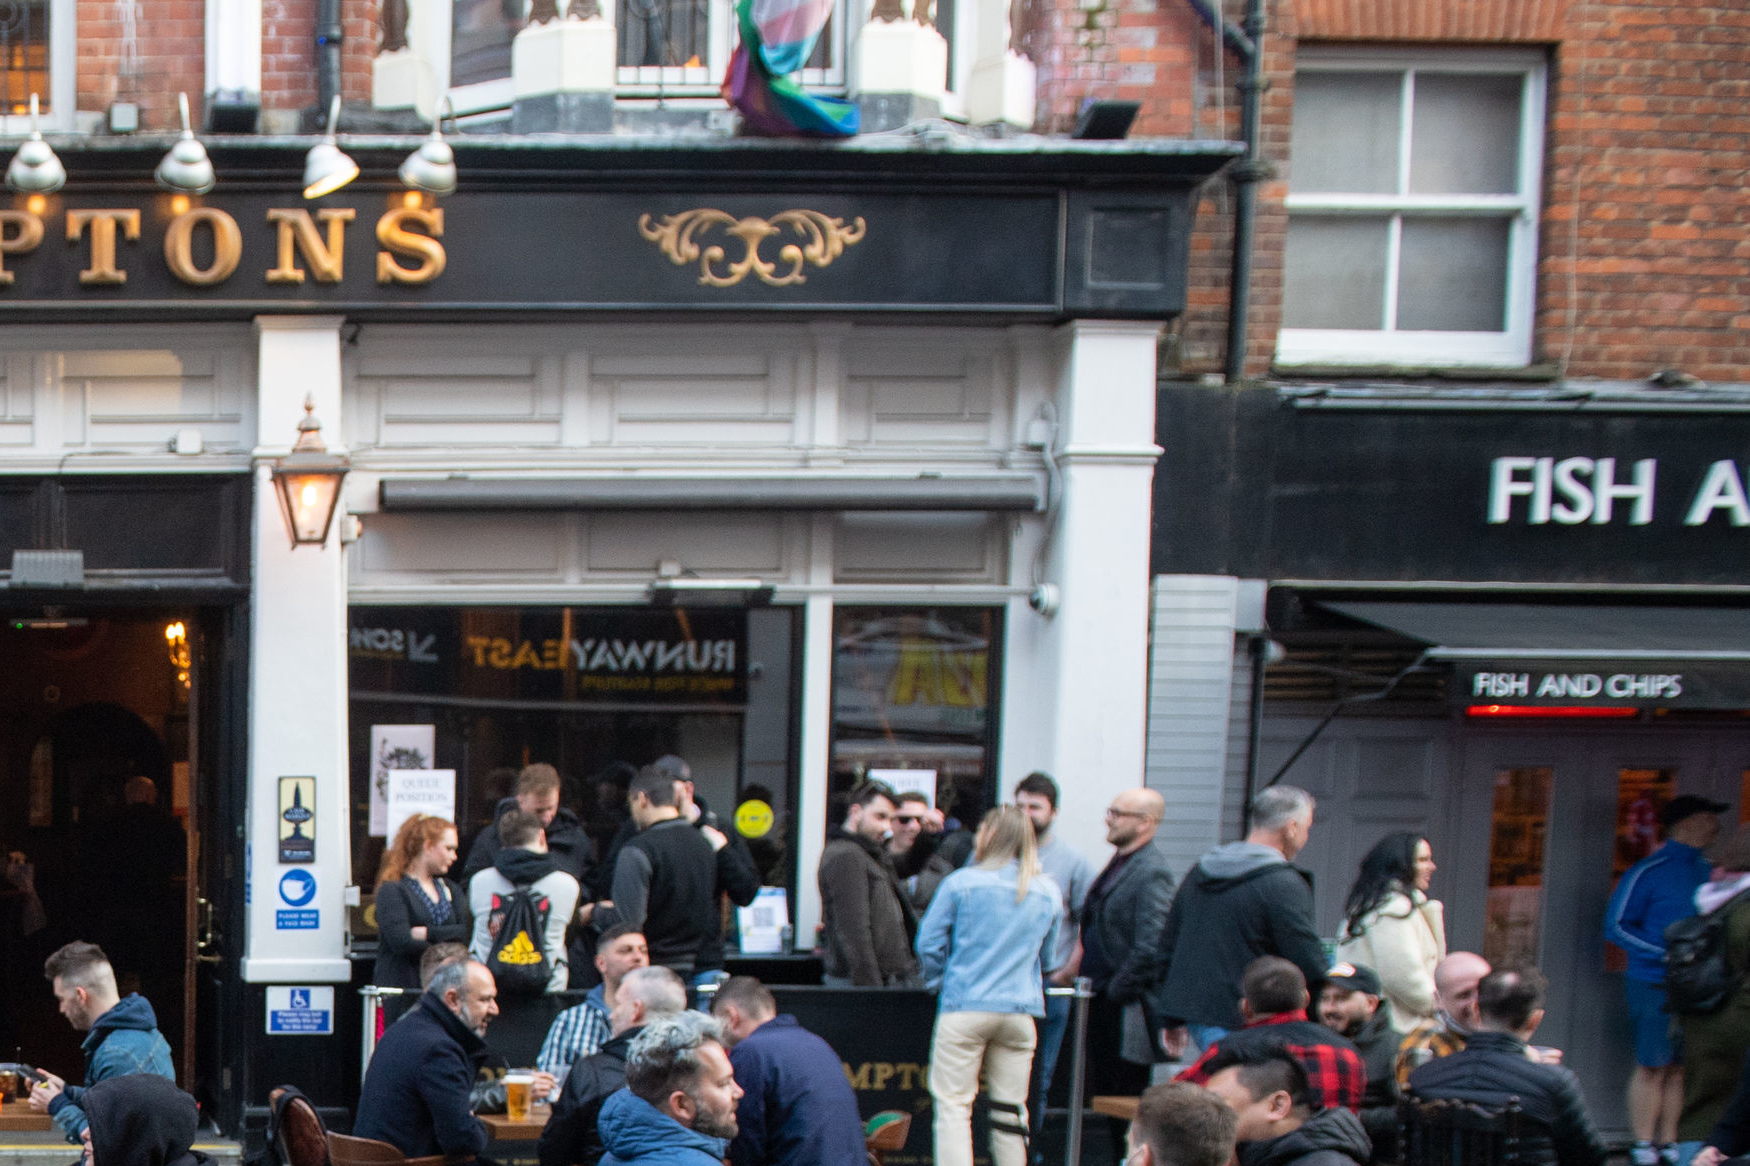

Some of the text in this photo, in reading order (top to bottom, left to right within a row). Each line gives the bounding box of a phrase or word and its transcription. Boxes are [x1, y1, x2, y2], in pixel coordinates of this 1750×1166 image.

[1486, 456, 1658, 526] FISH
[1472, 672, 1683, 698] FISH AND CHIPS
[497, 949, 543, 965] adidas
